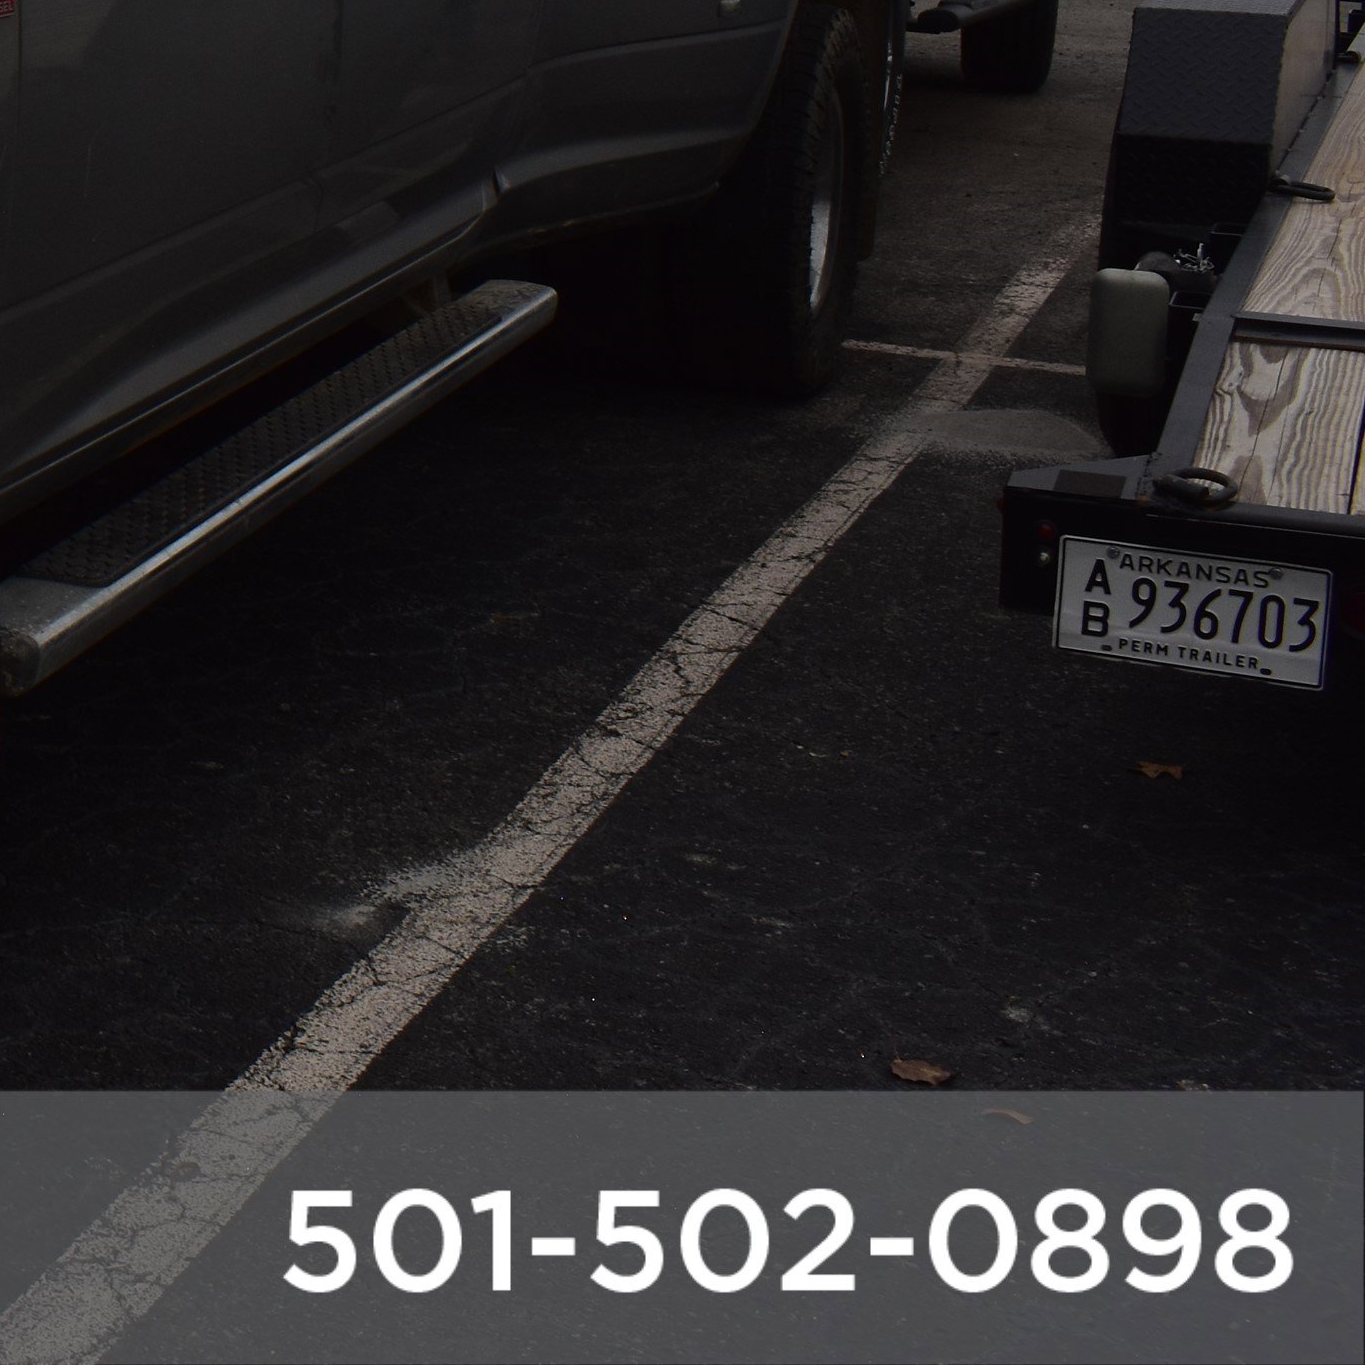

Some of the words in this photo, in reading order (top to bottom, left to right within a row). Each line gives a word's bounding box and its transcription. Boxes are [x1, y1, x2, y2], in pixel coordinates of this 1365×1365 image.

[1085, 558, 1112, 595] A
[1119, 553, 1269, 588] ARKANSAS
[1081, 600, 1110, 638] B
[1129, 577, 1320, 653] 936703
[1119, 638, 1169, 656] PERM
[1178, 646, 1259, 670] TRAILER
